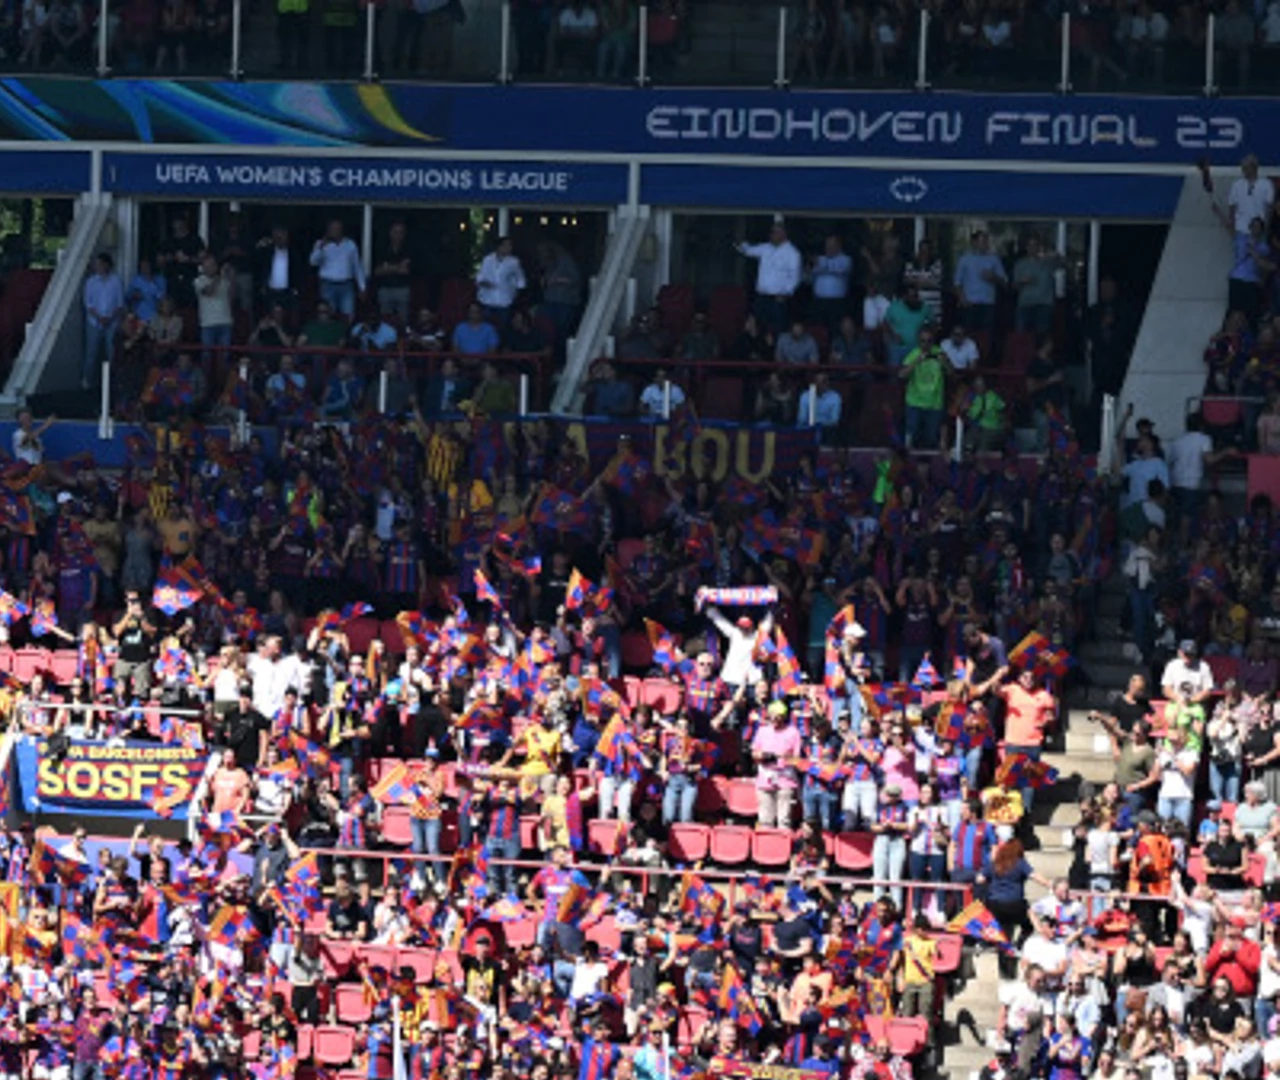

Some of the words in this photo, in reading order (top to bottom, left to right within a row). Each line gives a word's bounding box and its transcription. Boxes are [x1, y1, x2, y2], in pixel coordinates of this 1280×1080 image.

[645, 106, 963, 144] EINDHOVEN
[985, 111, 1158, 147] FINAL
[1176, 115, 1244, 149] 23
[155, 162, 211, 185] UEFA
[216, 164, 324, 187] WOMEN'S
[328, 167, 473, 190] CHAMPIONS
[479, 170, 570, 191] LEAGUE
